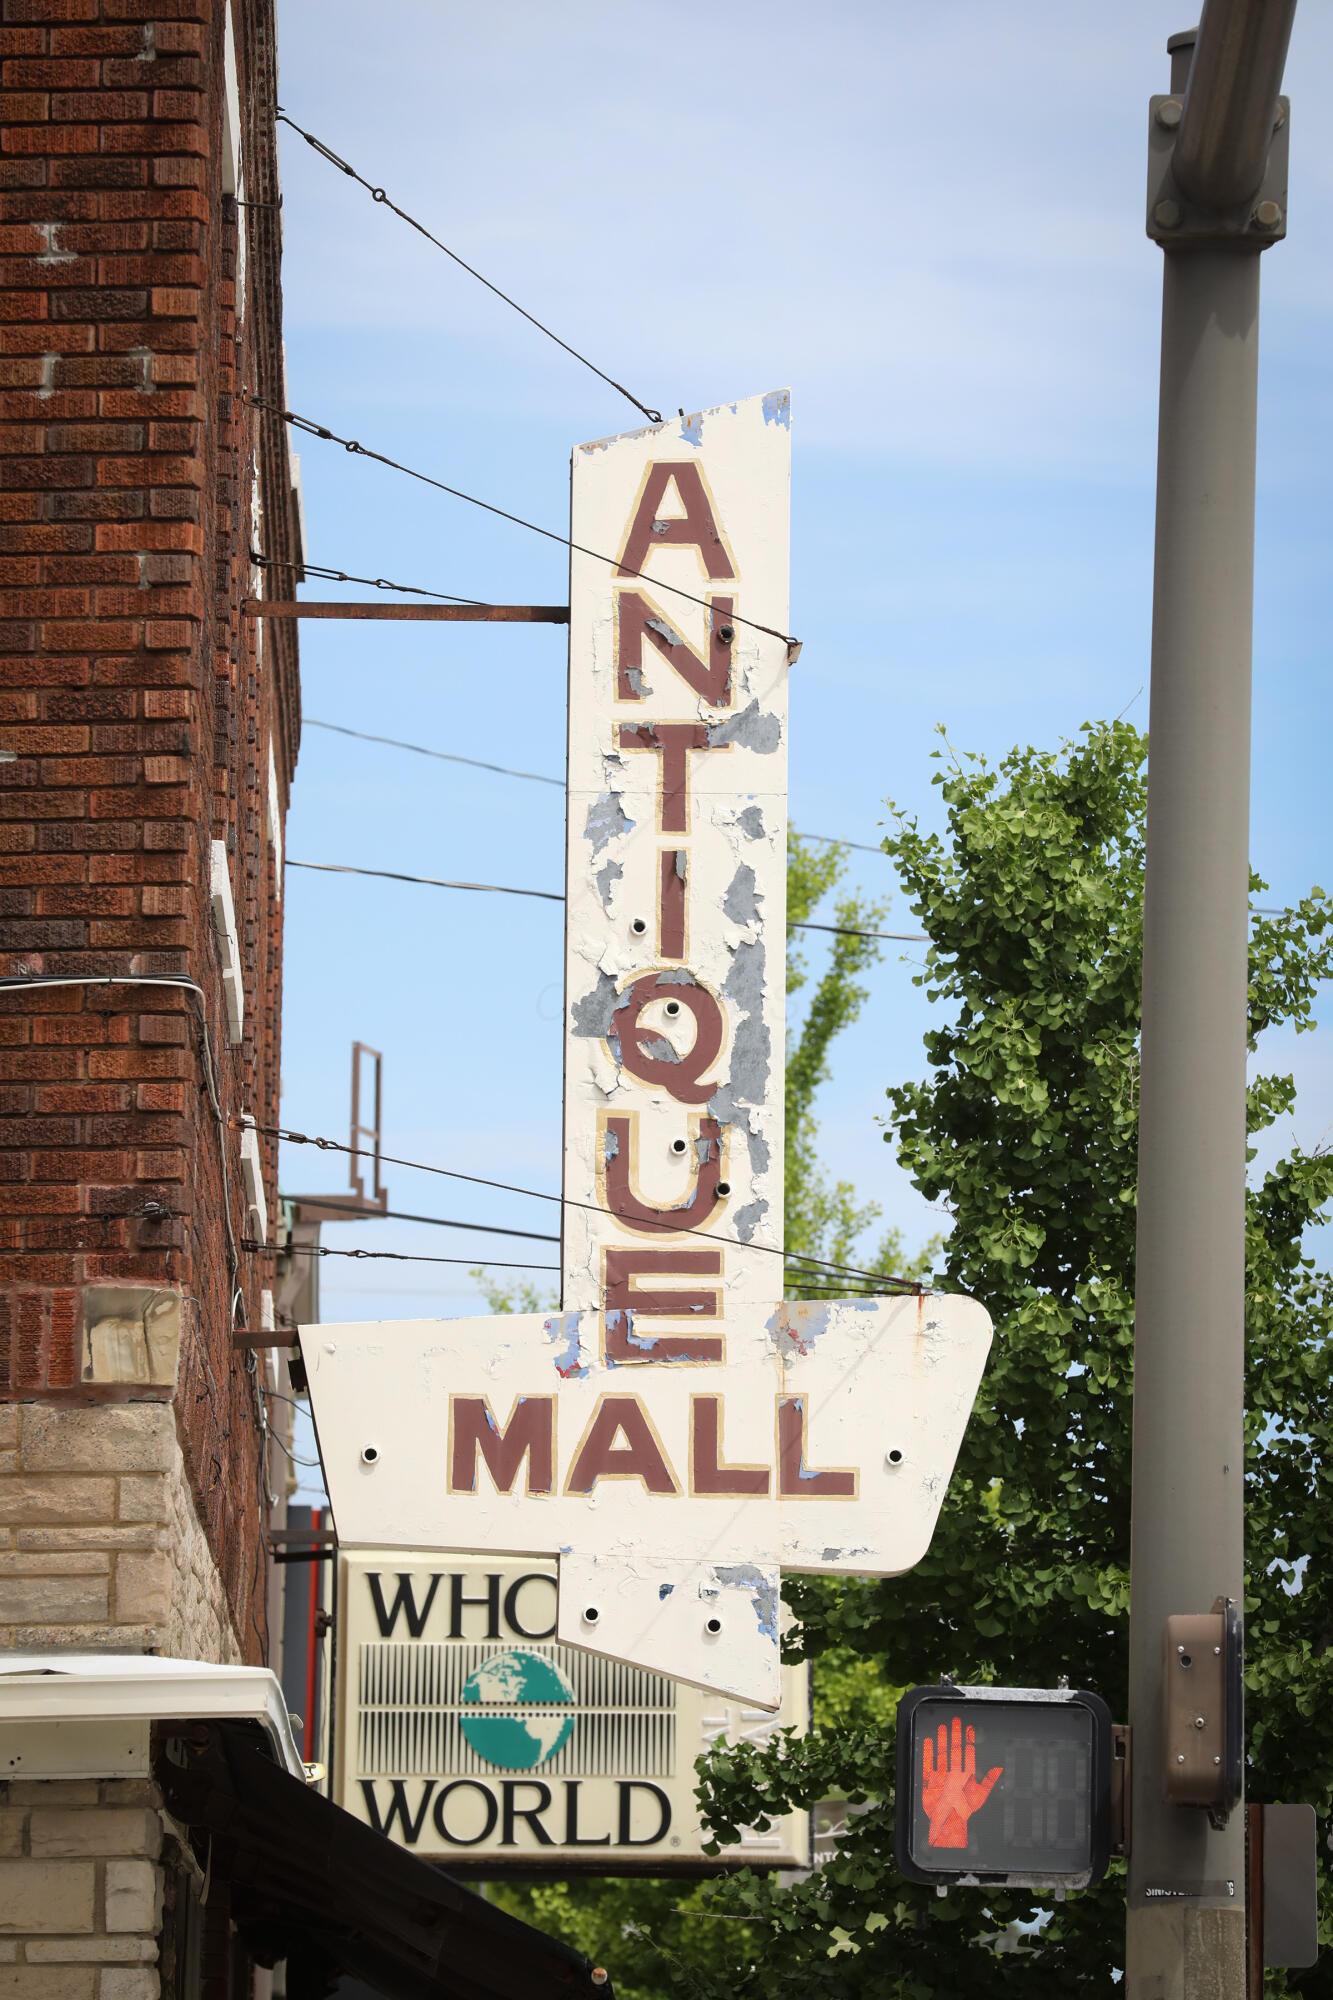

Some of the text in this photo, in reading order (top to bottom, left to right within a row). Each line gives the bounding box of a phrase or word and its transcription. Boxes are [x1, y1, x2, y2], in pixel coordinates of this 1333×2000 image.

[598, 459, 740, 1366] ANTIQUE
[447, 1394, 860, 1501] MALL
[358, 1780, 671, 1846] WORLD
